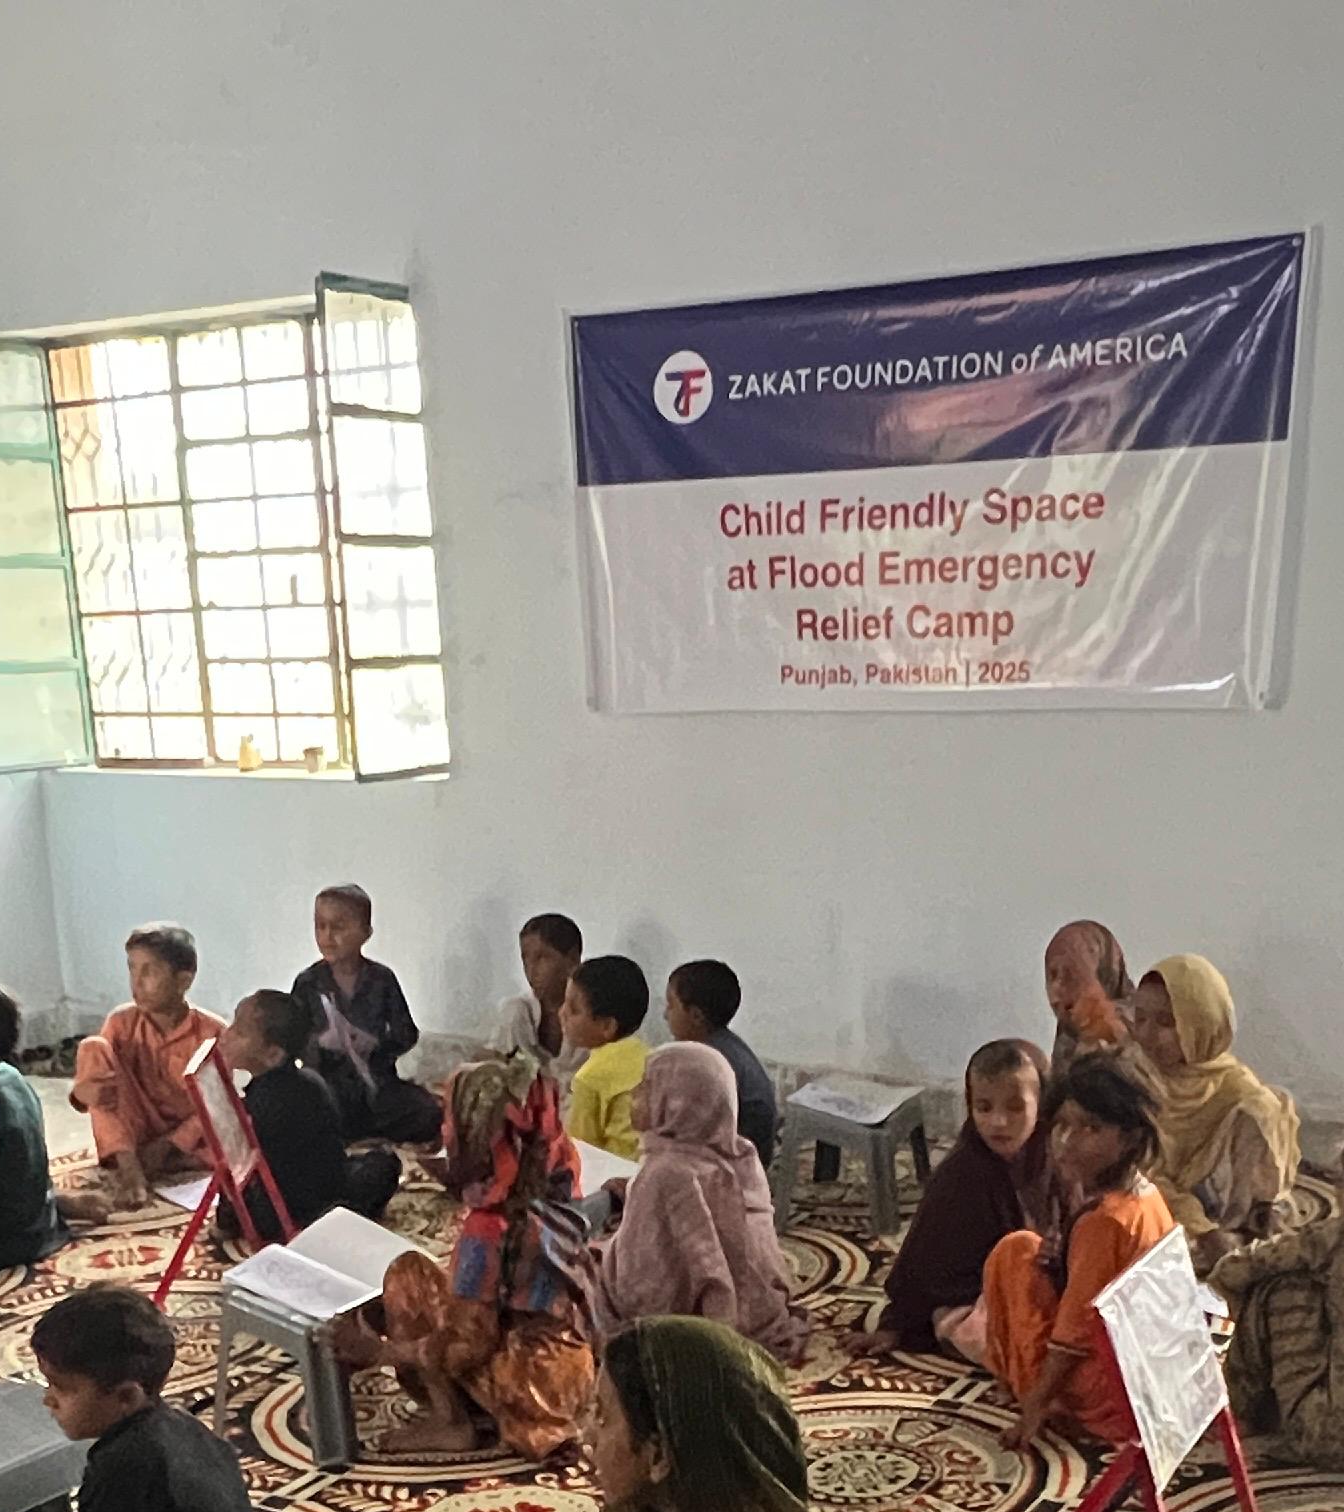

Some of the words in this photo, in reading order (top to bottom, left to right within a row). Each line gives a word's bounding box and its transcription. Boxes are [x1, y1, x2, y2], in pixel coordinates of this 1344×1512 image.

[728, 368, 811, 401] ZAKAT
[817, 350, 1004, 393] FOUNDATION
[1010, 344, 1045, 374] of
[1047, 332, 1188, 370] AMERICA
[719, 497, 806, 539] Child
[819, 491, 967, 535] Friendly
[982, 486, 1106, 526] Space
[727, 557, 758, 593] at
[768, 553, 865, 591] Flood
[878, 546, 1096, 591] Emergency
[797, 605, 894, 643] Relief
[906, 604, 1015, 646] Camp
[780, 663, 858, 688] Punjab,
[866, 661, 956, 686] Pakistan
[978, 660, 1031, 683] 2025
